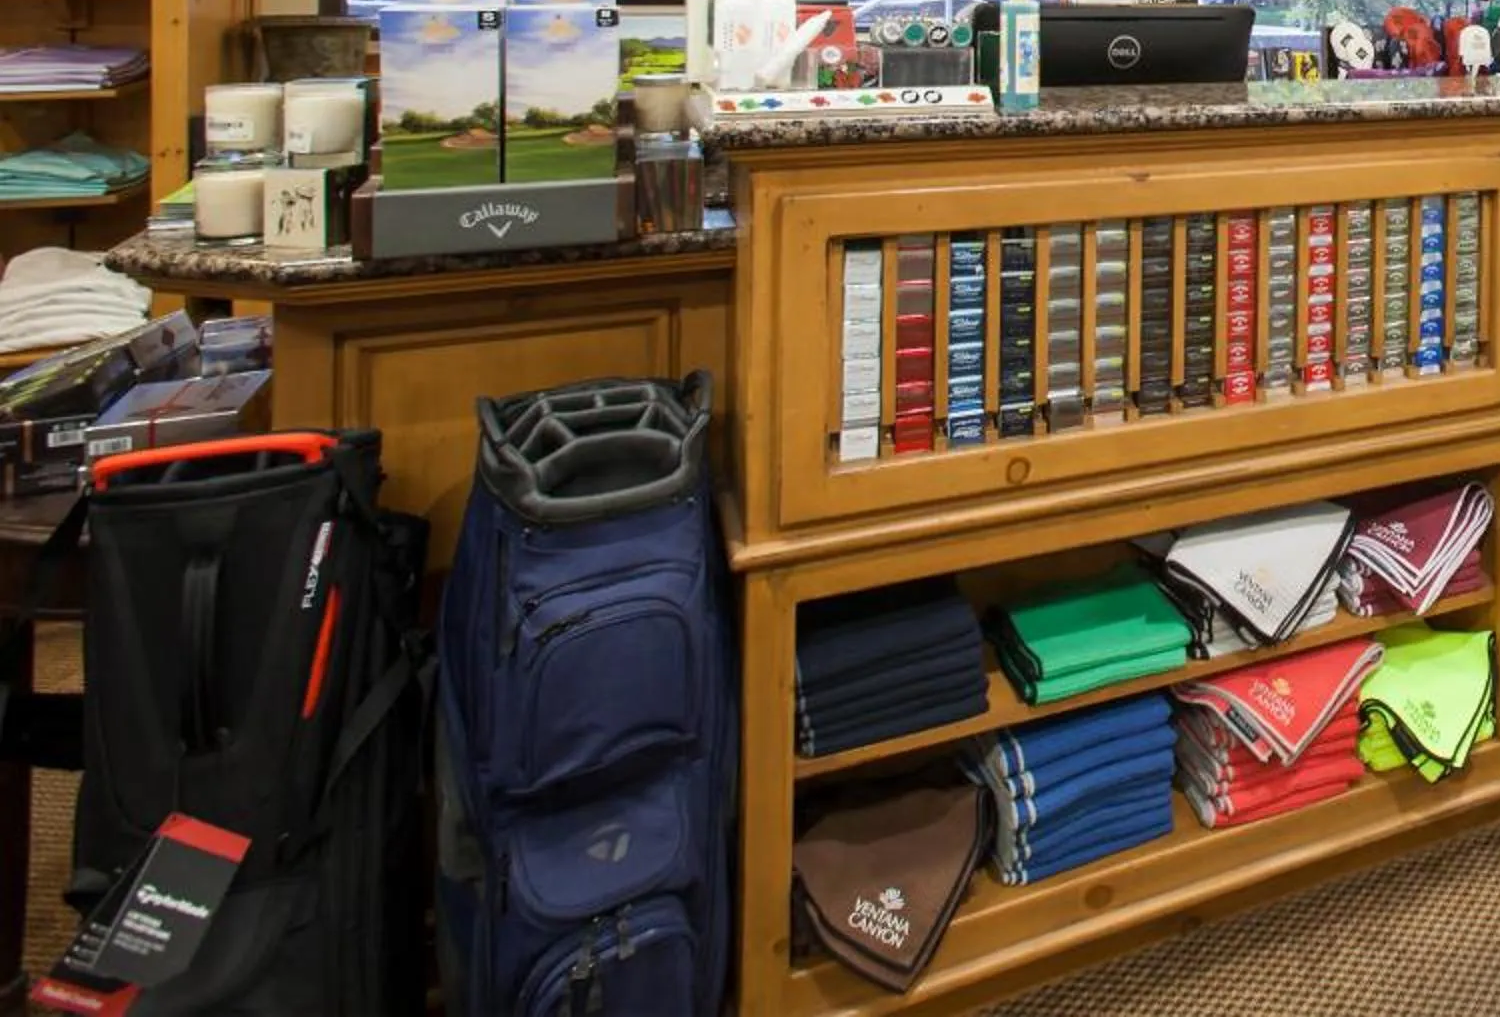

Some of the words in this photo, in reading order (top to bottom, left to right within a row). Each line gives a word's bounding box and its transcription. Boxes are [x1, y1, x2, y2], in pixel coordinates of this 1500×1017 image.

[459, 202, 540, 229] Callaway
[847, 912, 905, 949] CANYON
[855, 894, 910, 935] VENTANA
